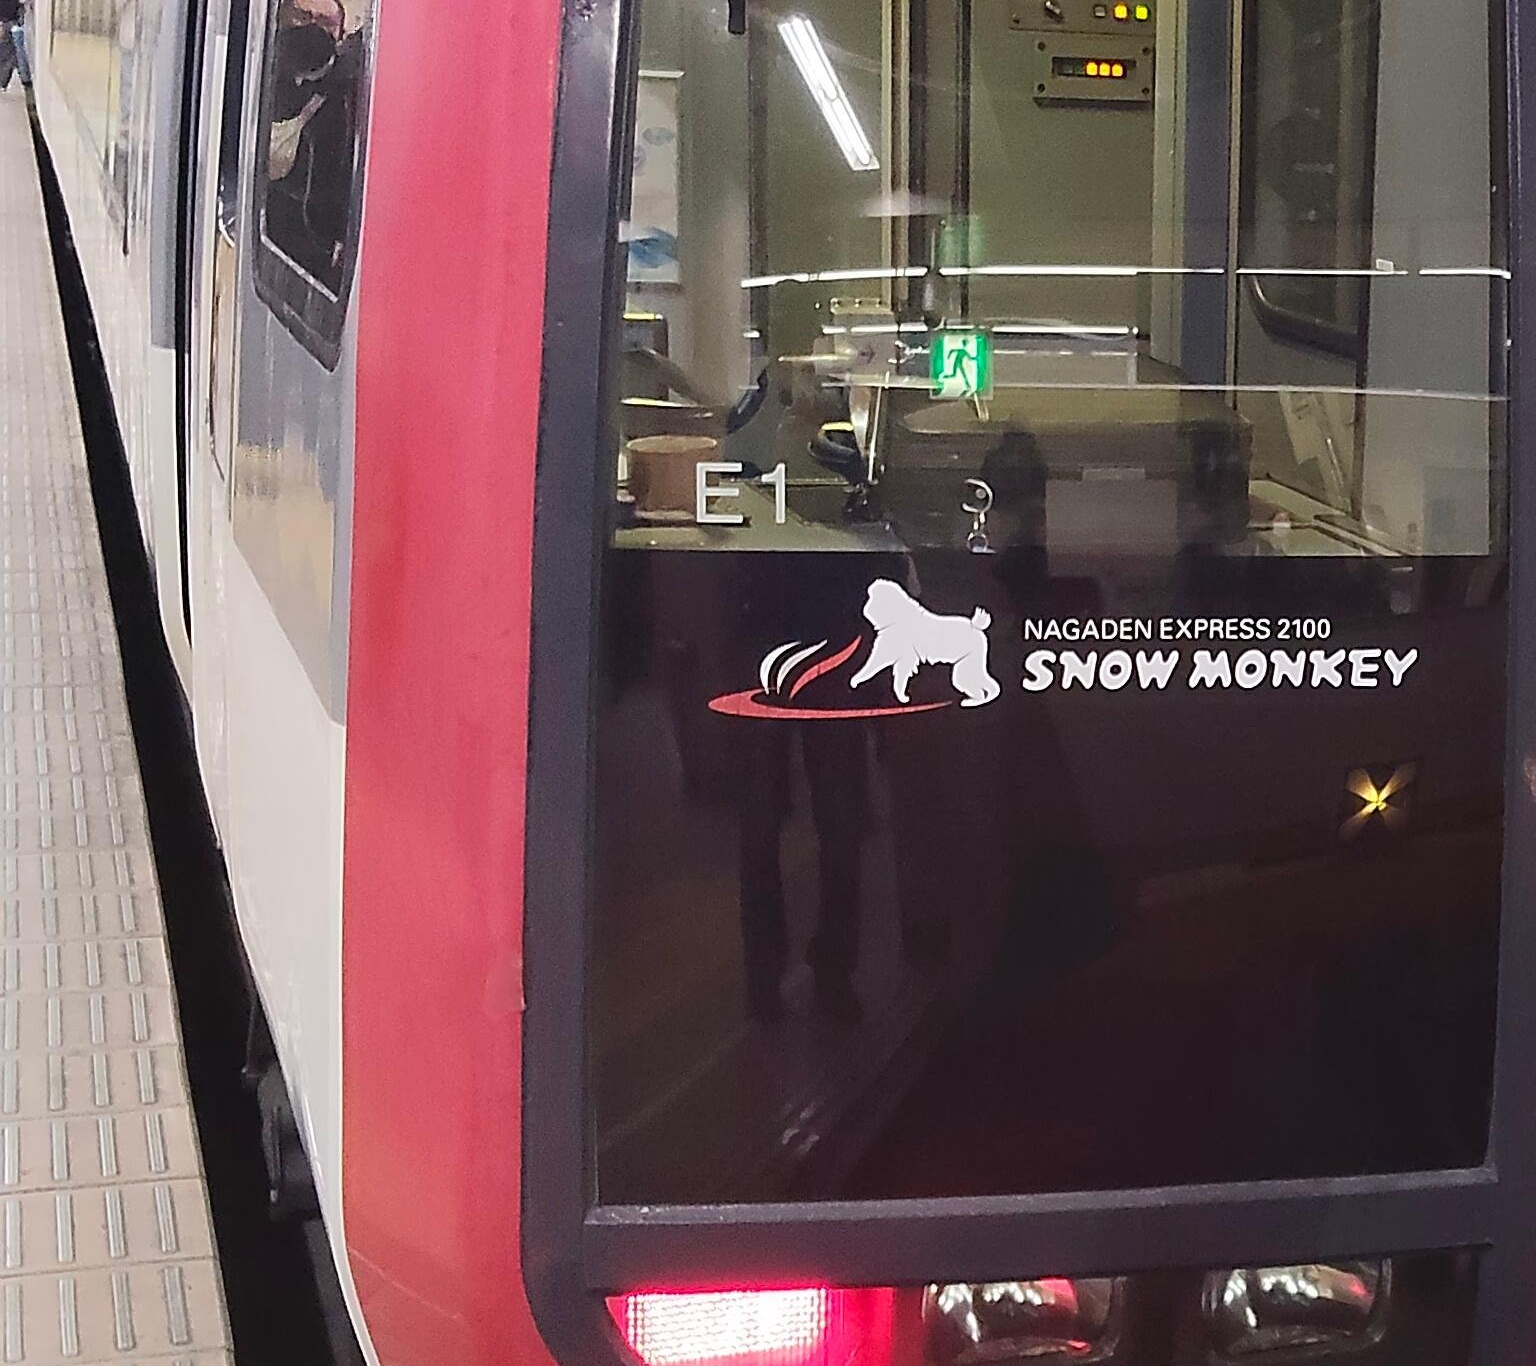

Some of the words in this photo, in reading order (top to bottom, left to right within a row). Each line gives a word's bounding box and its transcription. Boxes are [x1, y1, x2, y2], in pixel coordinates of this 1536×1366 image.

[695, 461, 786, 524] E1
[1023, 618, 1153, 641] NAGADEN
[1159, 618, 1271, 640] EXPRESS
[1276, 618, 1332, 640] 2100
[1022, 649, 1179, 692] SNOW
[1188, 648, 1418, 690] MONKEY
